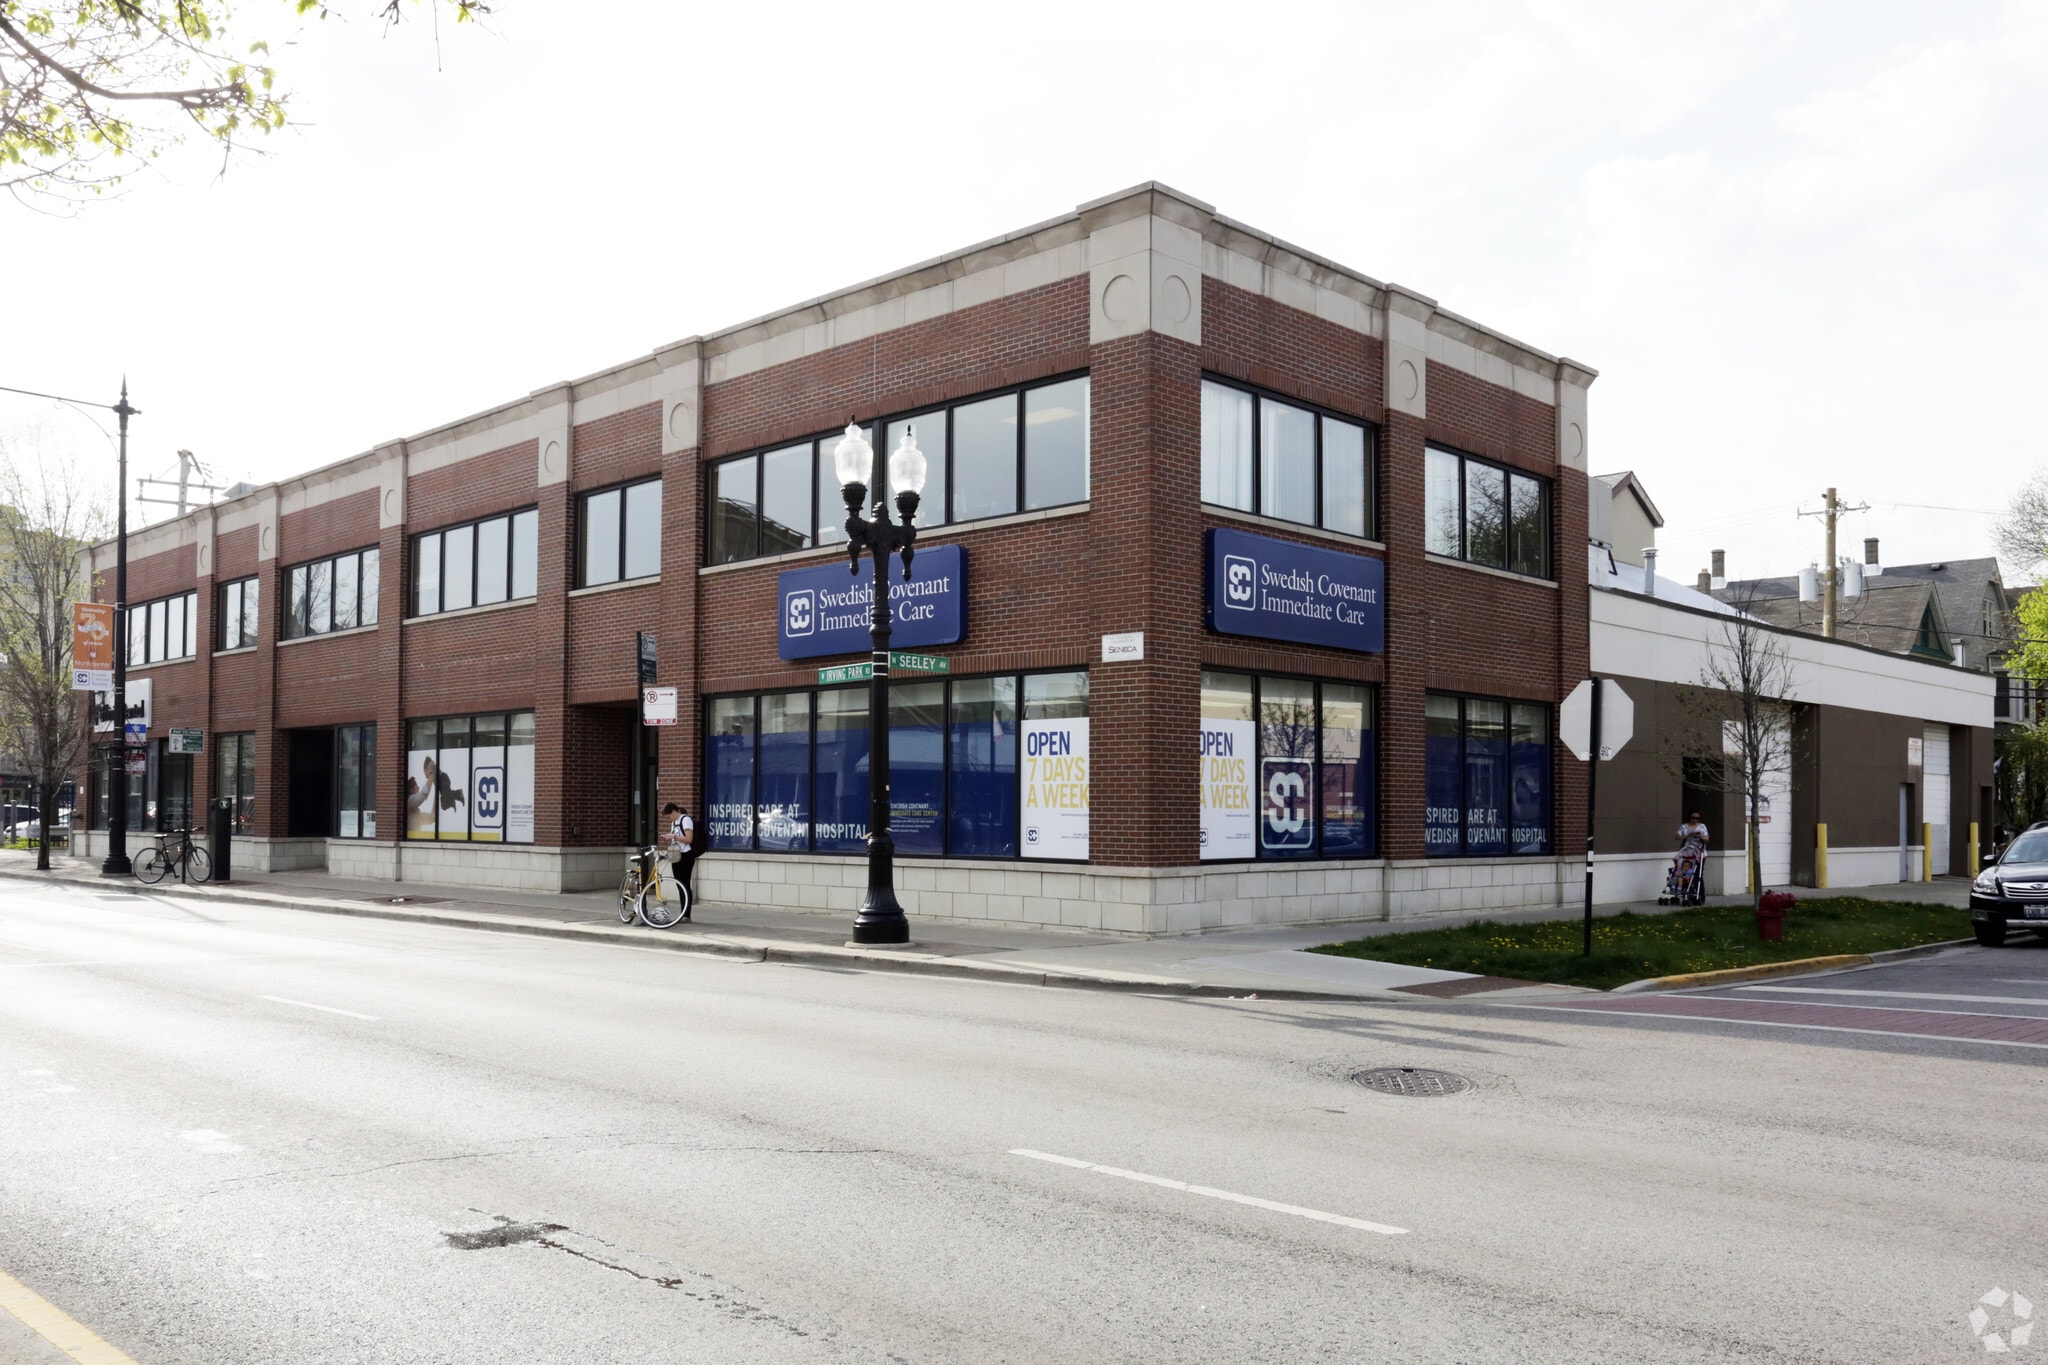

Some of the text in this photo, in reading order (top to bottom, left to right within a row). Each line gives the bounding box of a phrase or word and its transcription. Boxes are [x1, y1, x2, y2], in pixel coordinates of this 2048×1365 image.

[819, 576, 950, 609] Swedish ovenant
[1261, 564, 1377, 604] Swedish Covenant
[899, 600, 935, 622] Care
[1261, 589, 1365, 625] Immediate Care
[1108, 646, 1137, 654] SENECA
[826, 668, 846, 682] IRVING
[848, 666, 863, 679] PARK
[900, 655, 936, 670] SEELEY
[1027, 731, 1070, 756] OPEN
[1200, 731, 1233, 756] OPEN
[1027, 757, 1086, 782] 7 DAYS
[1211, 757, 1245, 783] DAYS
[1026, 784, 1089, 808] A WEEK
[1210, 784, 1250, 809] WEEK
[709, 804, 800, 818] INSPIRED CARE AT
[1426, 807, 1497, 823] SPIRED ARE AT
[709, 822, 867, 839] SWEDISH COVENANT HOSPITAL
[1424, 828, 1459, 843] WEDISH
[1467, 828, 1507, 843] OVENANT
